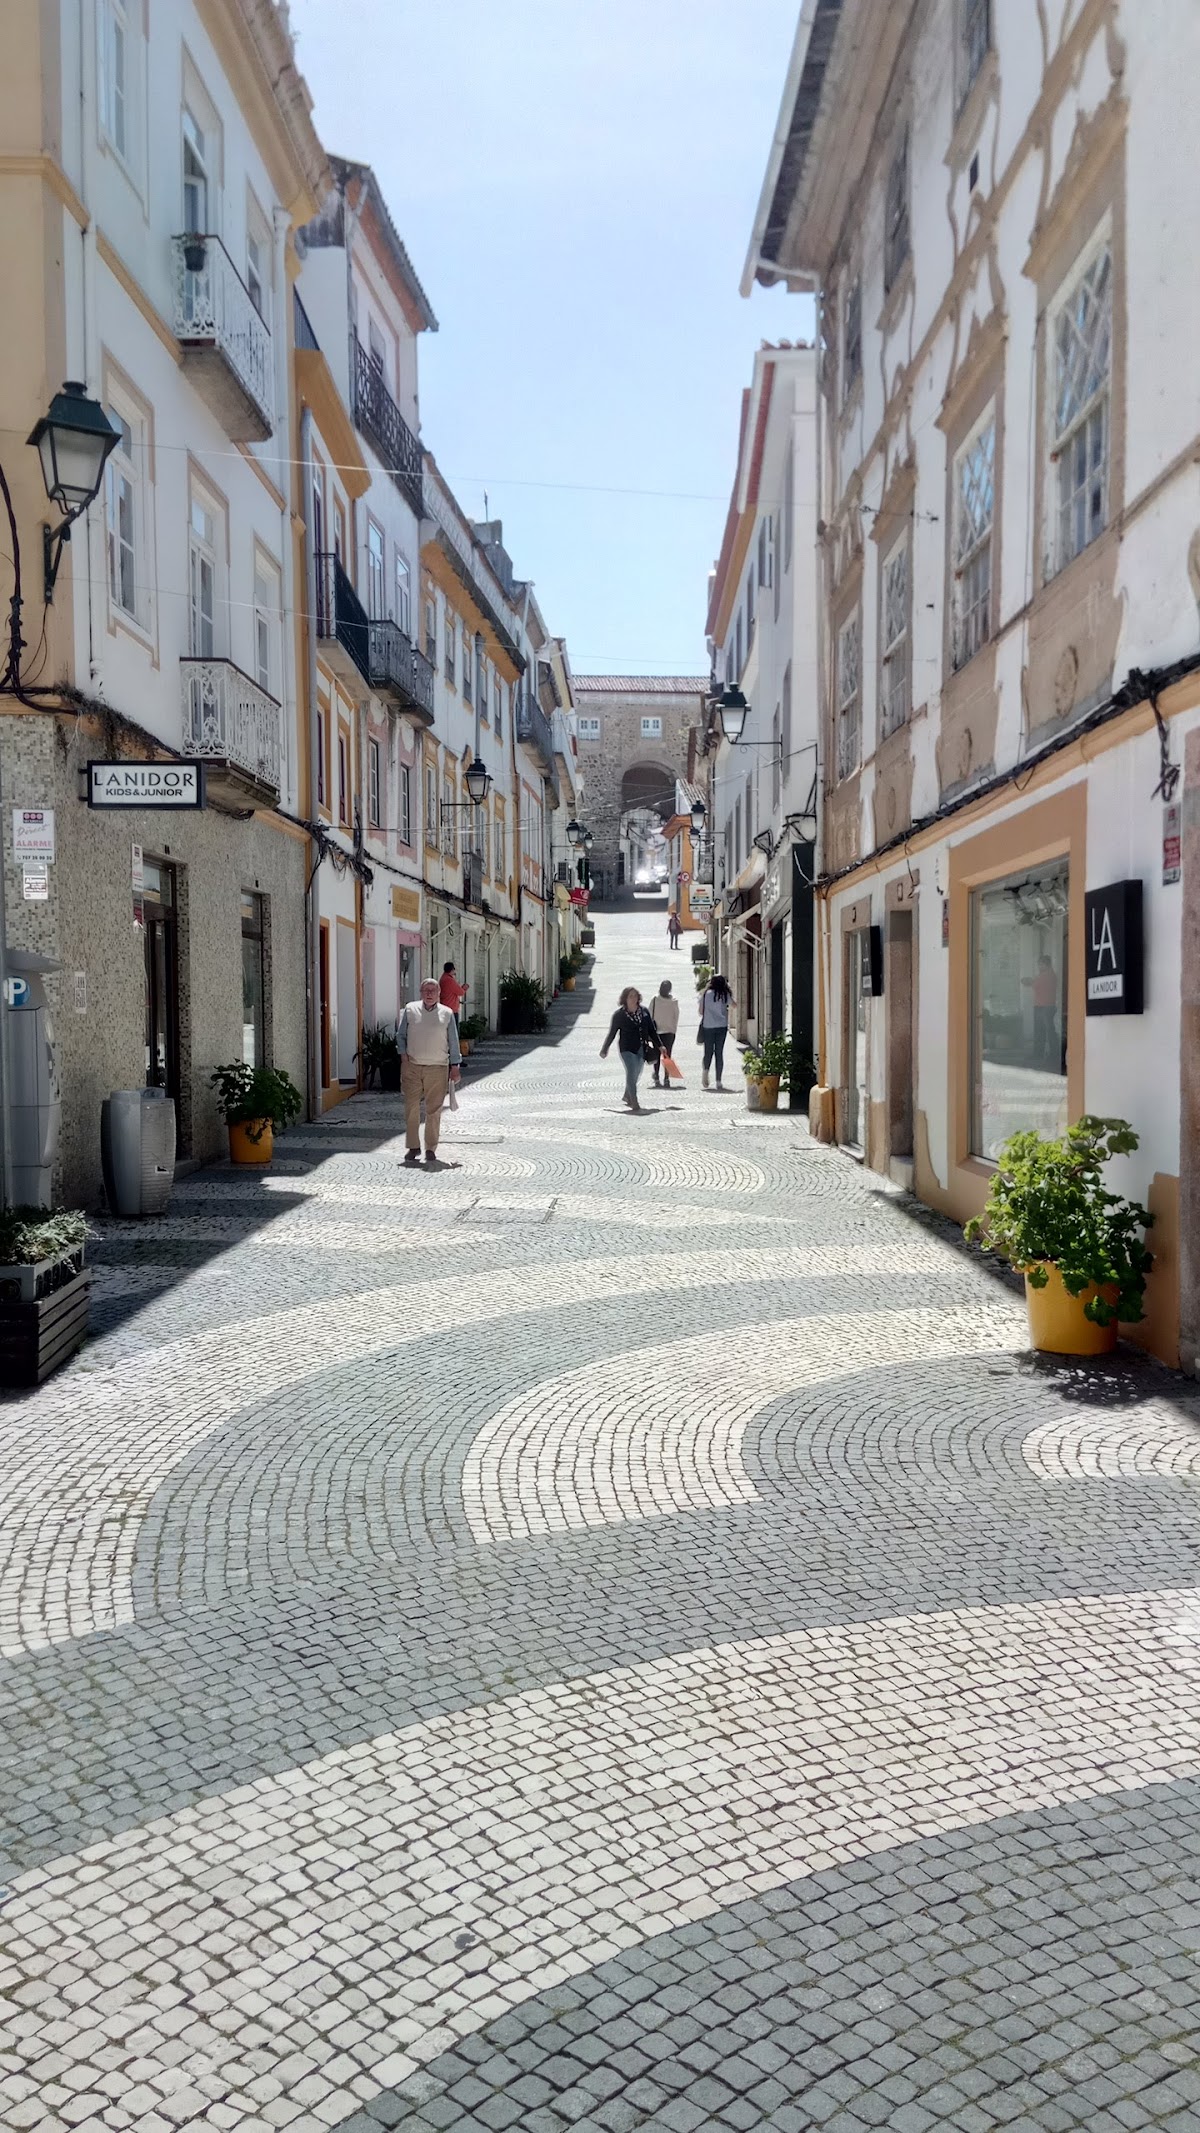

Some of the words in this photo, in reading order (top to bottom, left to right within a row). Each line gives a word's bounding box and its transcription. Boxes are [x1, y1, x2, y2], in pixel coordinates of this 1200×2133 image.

[94, 772, 194, 787] LANIDOR
[105, 788, 183, 797] KIDS&JUNIOR
[16, 840, 52, 848] ALARME
[1091, 906, 1117, 971] LA
[8, 977, 27, 1005] P
[1092, 980, 1118, 994] LANIDOR
